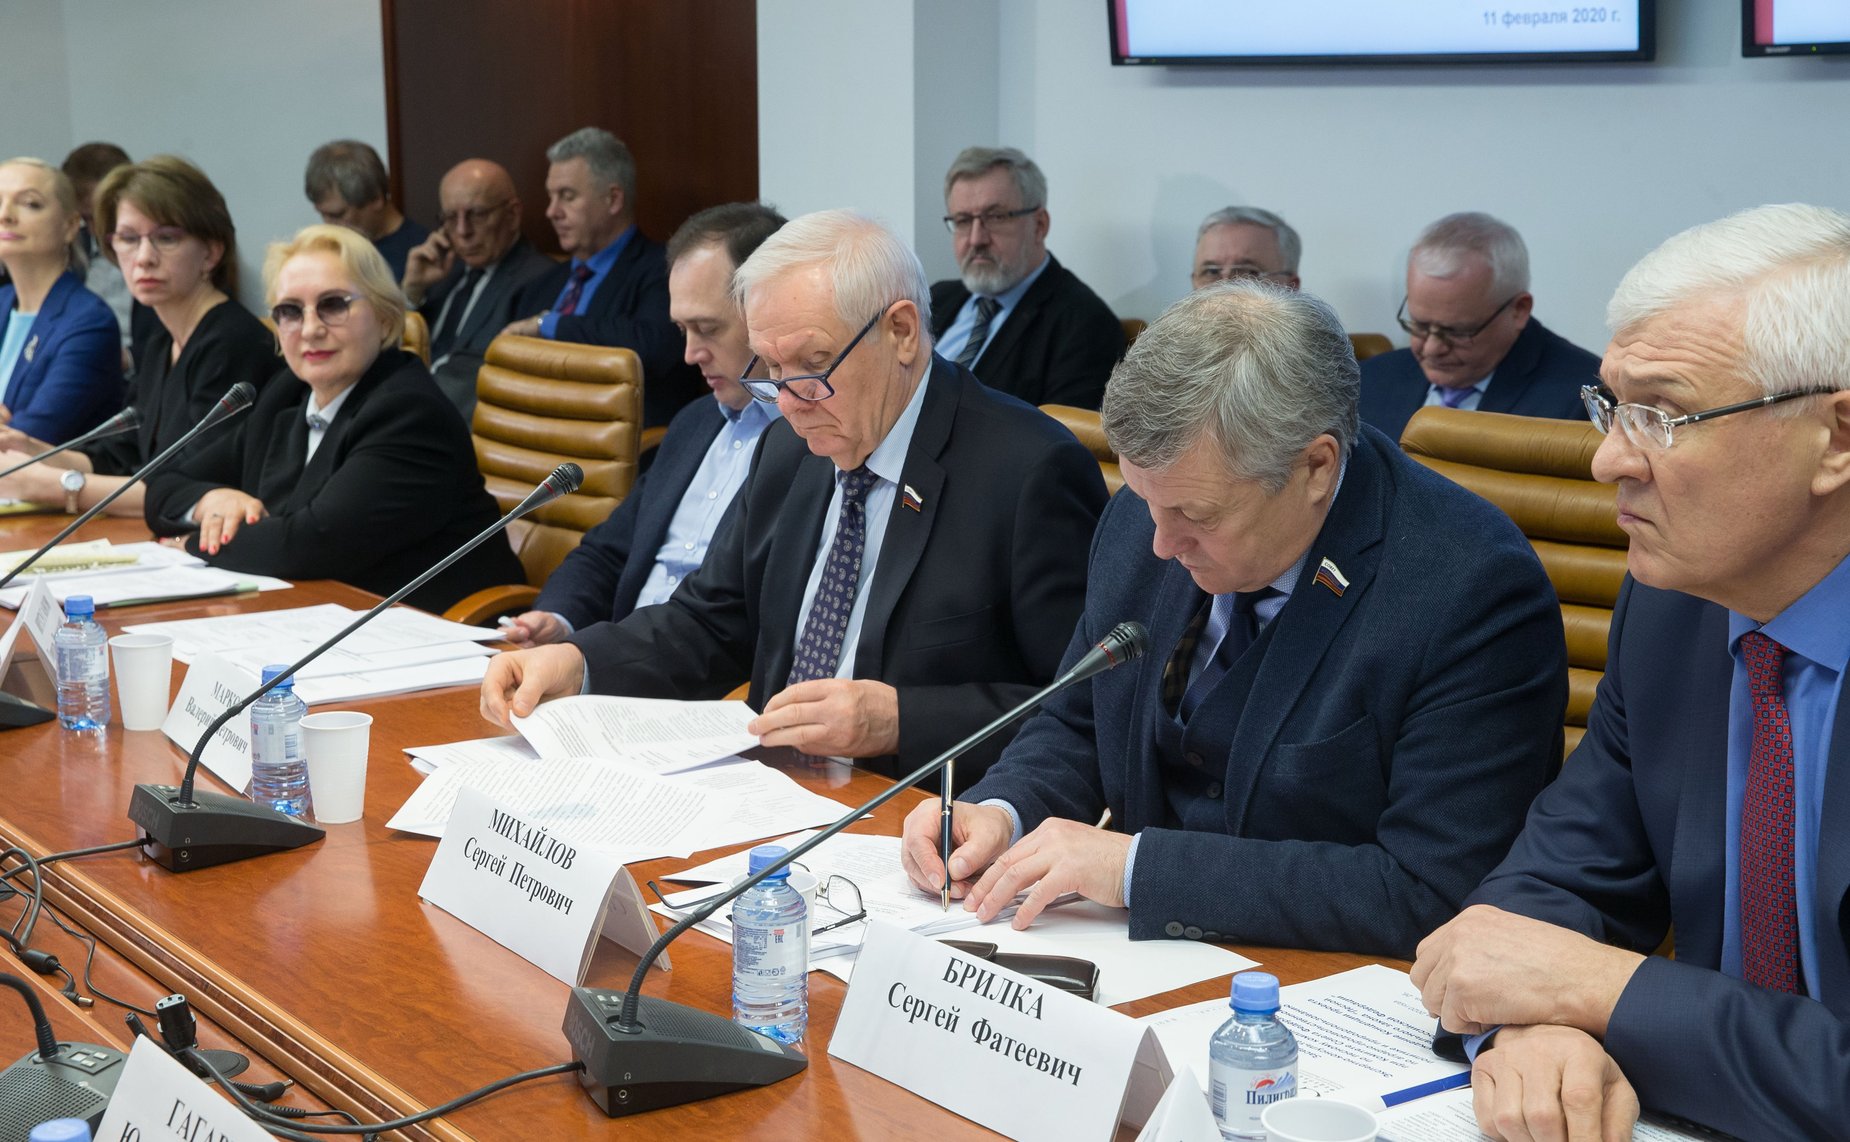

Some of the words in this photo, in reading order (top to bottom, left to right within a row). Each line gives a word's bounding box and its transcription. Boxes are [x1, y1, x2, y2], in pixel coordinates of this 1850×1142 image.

[1484, 10, 1496, 26] 11
[1502, 11, 1568, 28] февраля
[1572, 8, 1607, 23] 2020
[1611, 10, 1621, 22] г.
[213, 725, 248, 754] етрович
[488, 808, 577, 871] МИХАЙЛОВ
[463, 837, 507, 878] Сергей
[509, 863, 574, 916] Петрович
[940, 956, 1044, 1021] БРИЛКА
[888, 981, 960, 1034] Сергей
[970, 1018, 1083, 1087] Фатеевич
